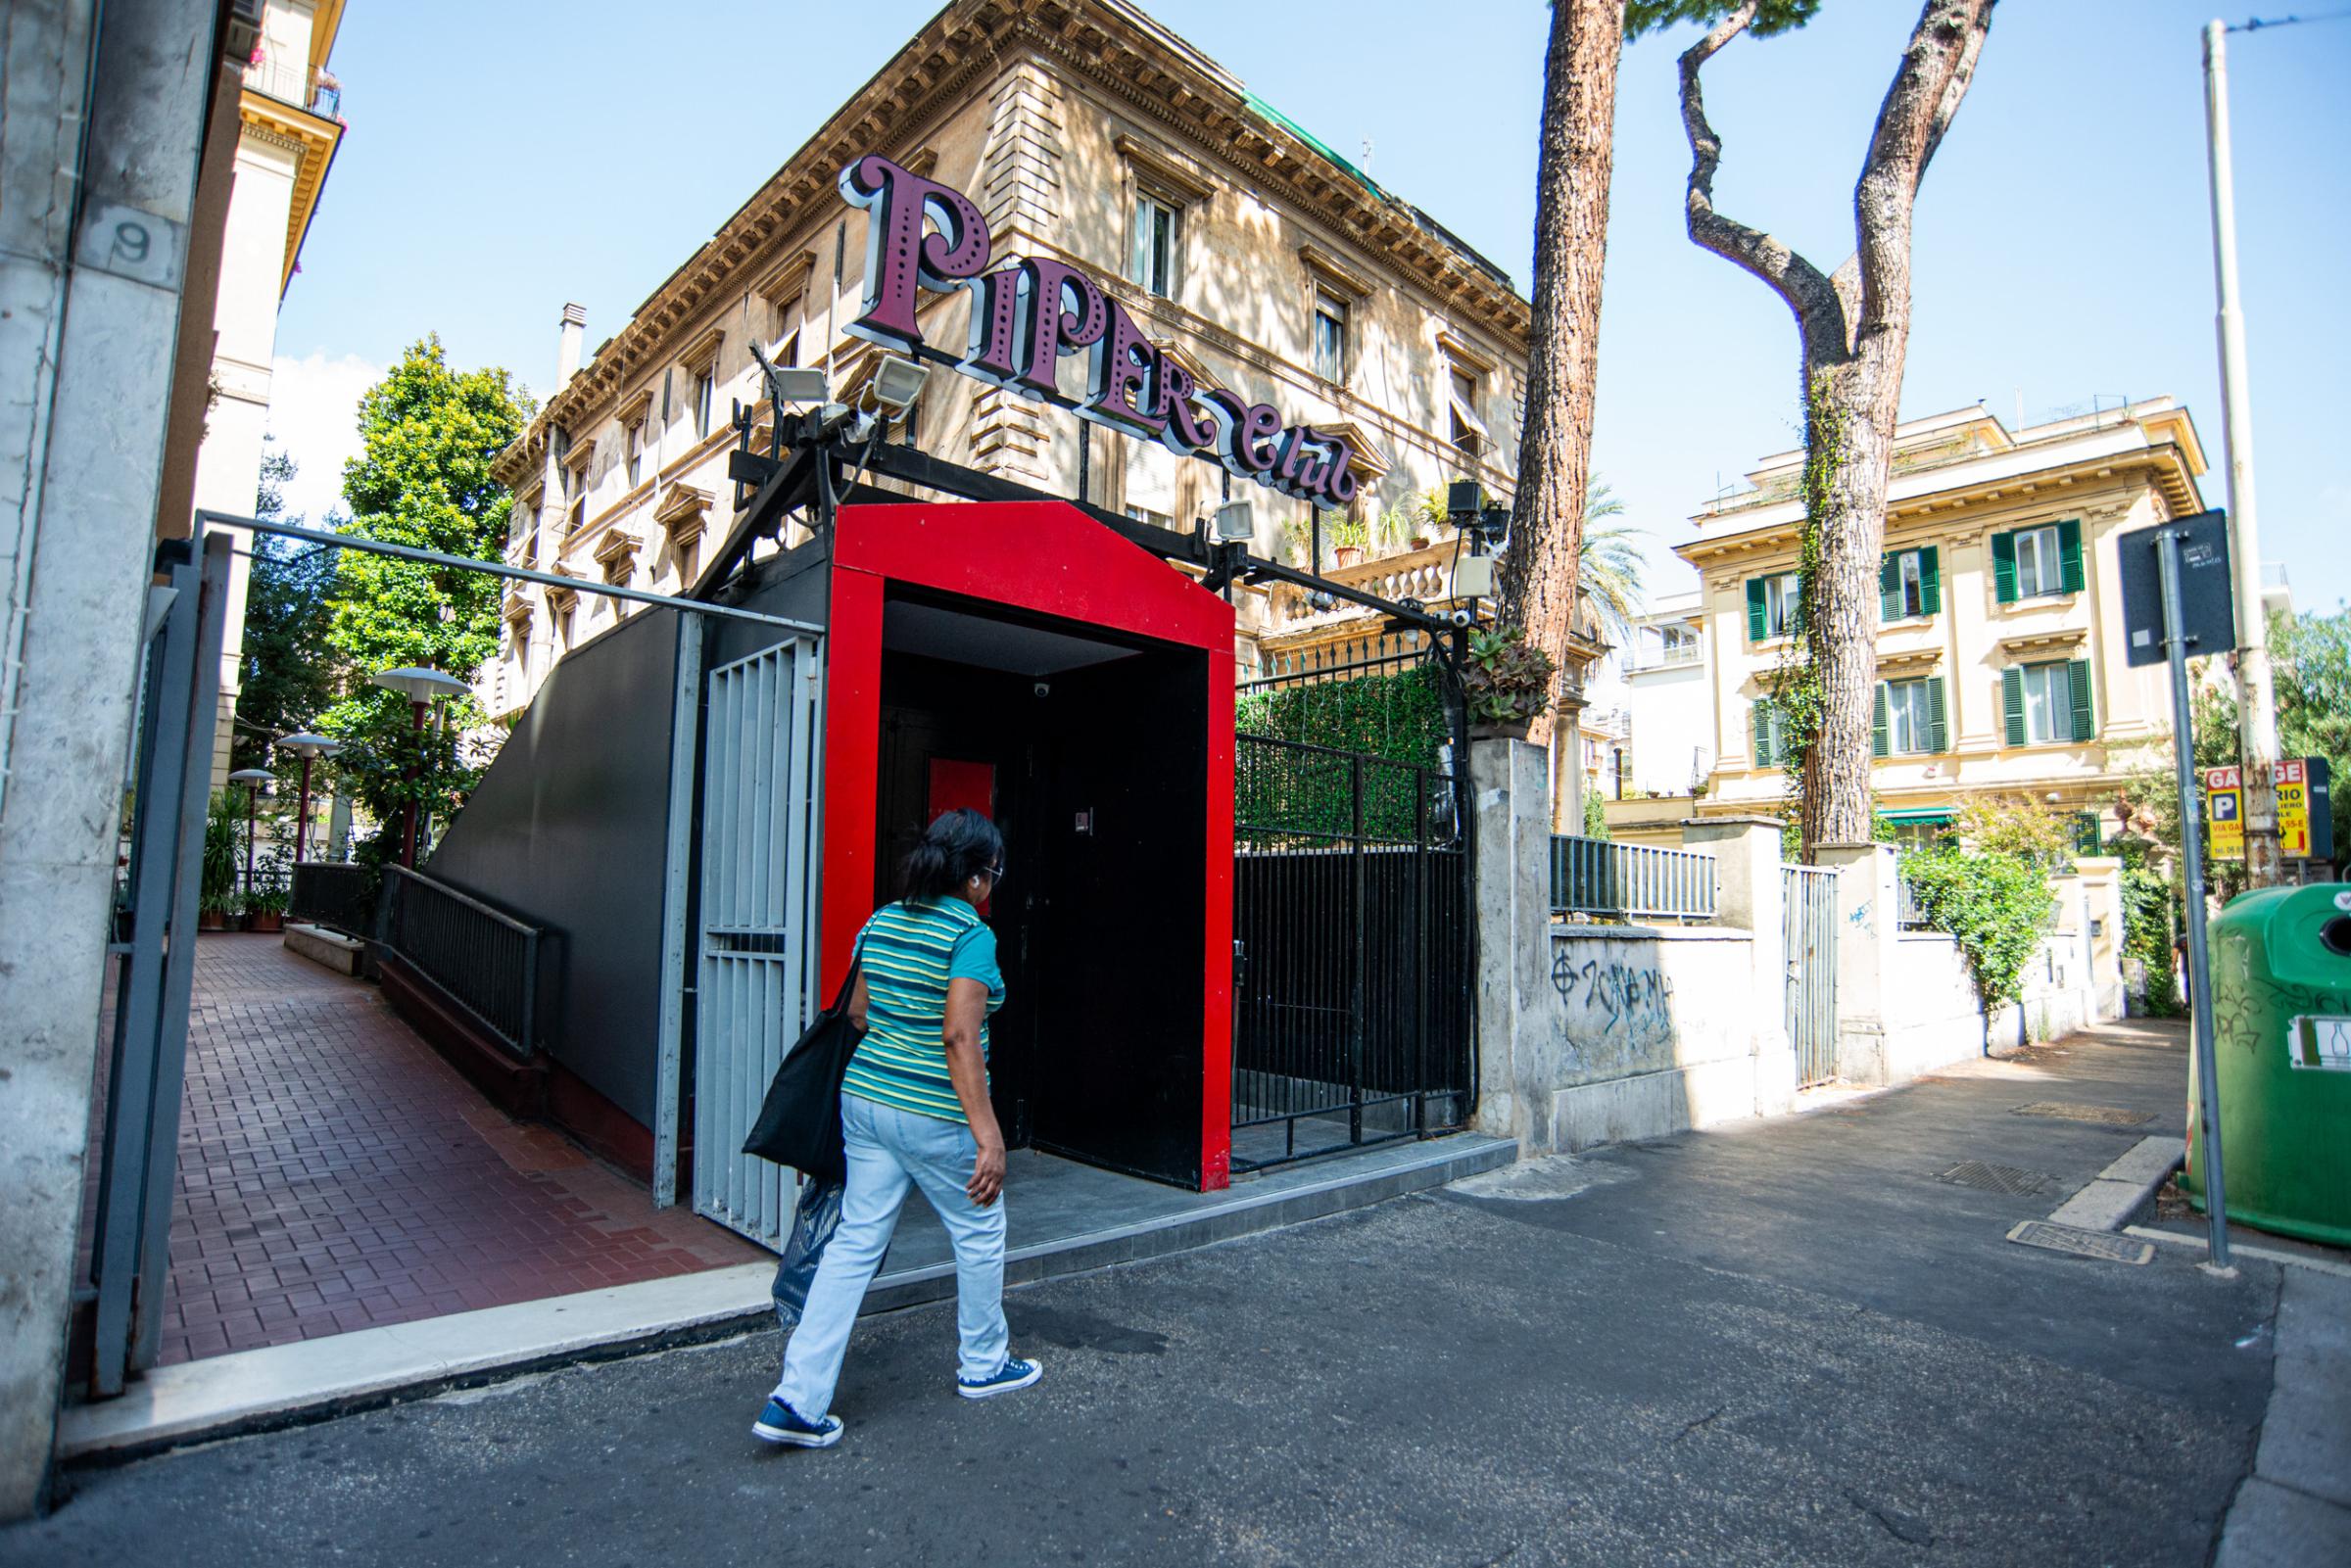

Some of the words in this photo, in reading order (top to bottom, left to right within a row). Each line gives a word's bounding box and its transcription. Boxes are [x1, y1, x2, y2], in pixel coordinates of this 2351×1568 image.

[116, 221, 151, 263] 9
[840, 154, 1216, 456] PIPER
[2209, 763, 2301, 788] GAGE
[2214, 797, 2233, 819] P
